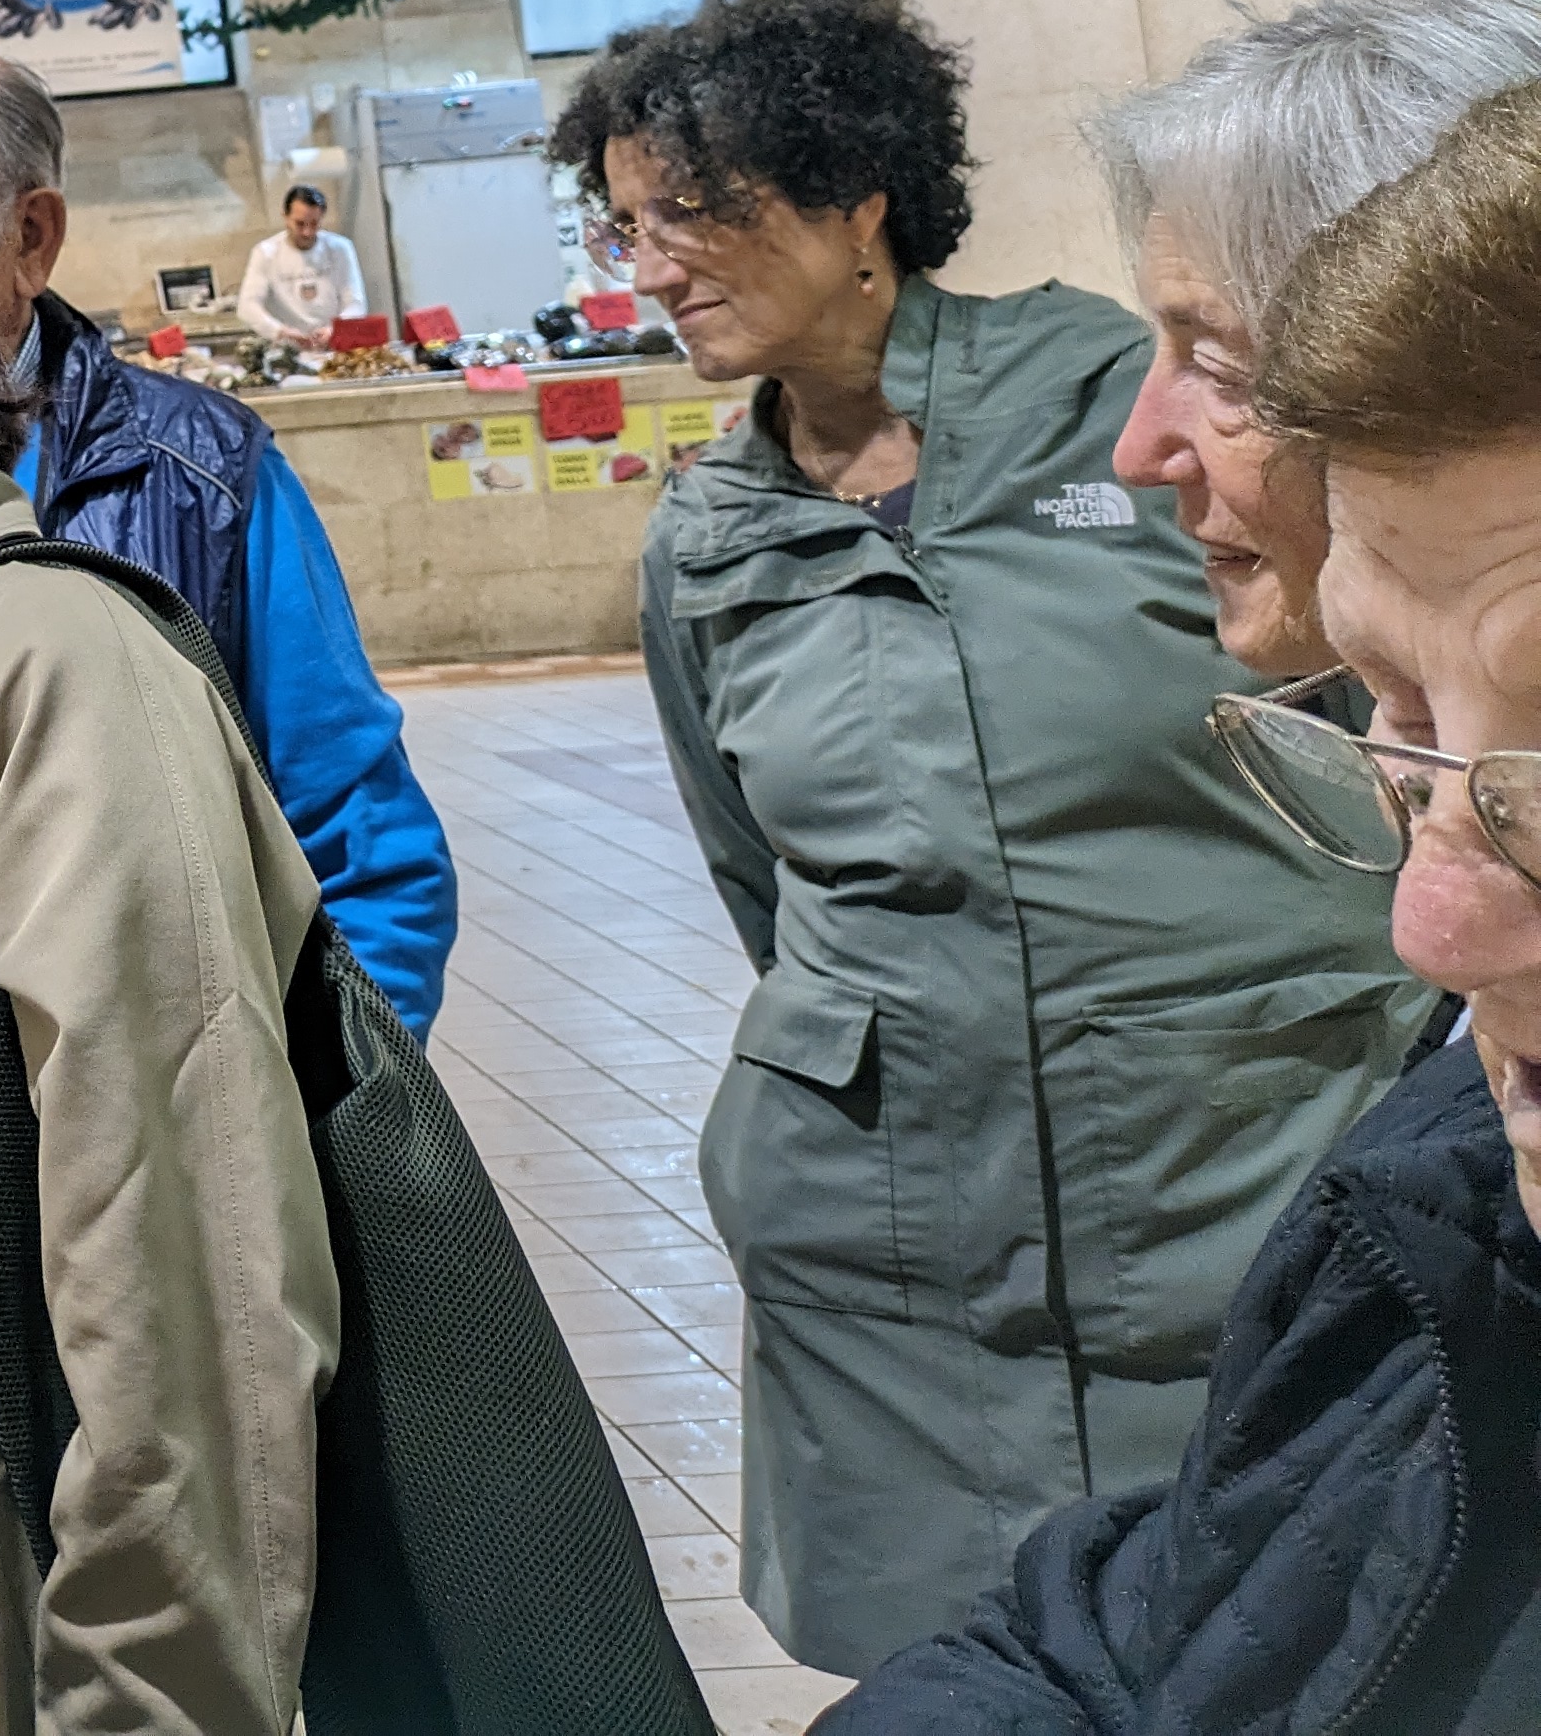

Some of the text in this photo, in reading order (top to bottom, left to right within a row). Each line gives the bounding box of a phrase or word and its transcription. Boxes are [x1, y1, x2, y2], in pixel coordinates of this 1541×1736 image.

[1061, 483, 1100, 498] THE
[1033, 498, 1100, 516] NORTH
[1054, 511, 1102, 529] FACE
